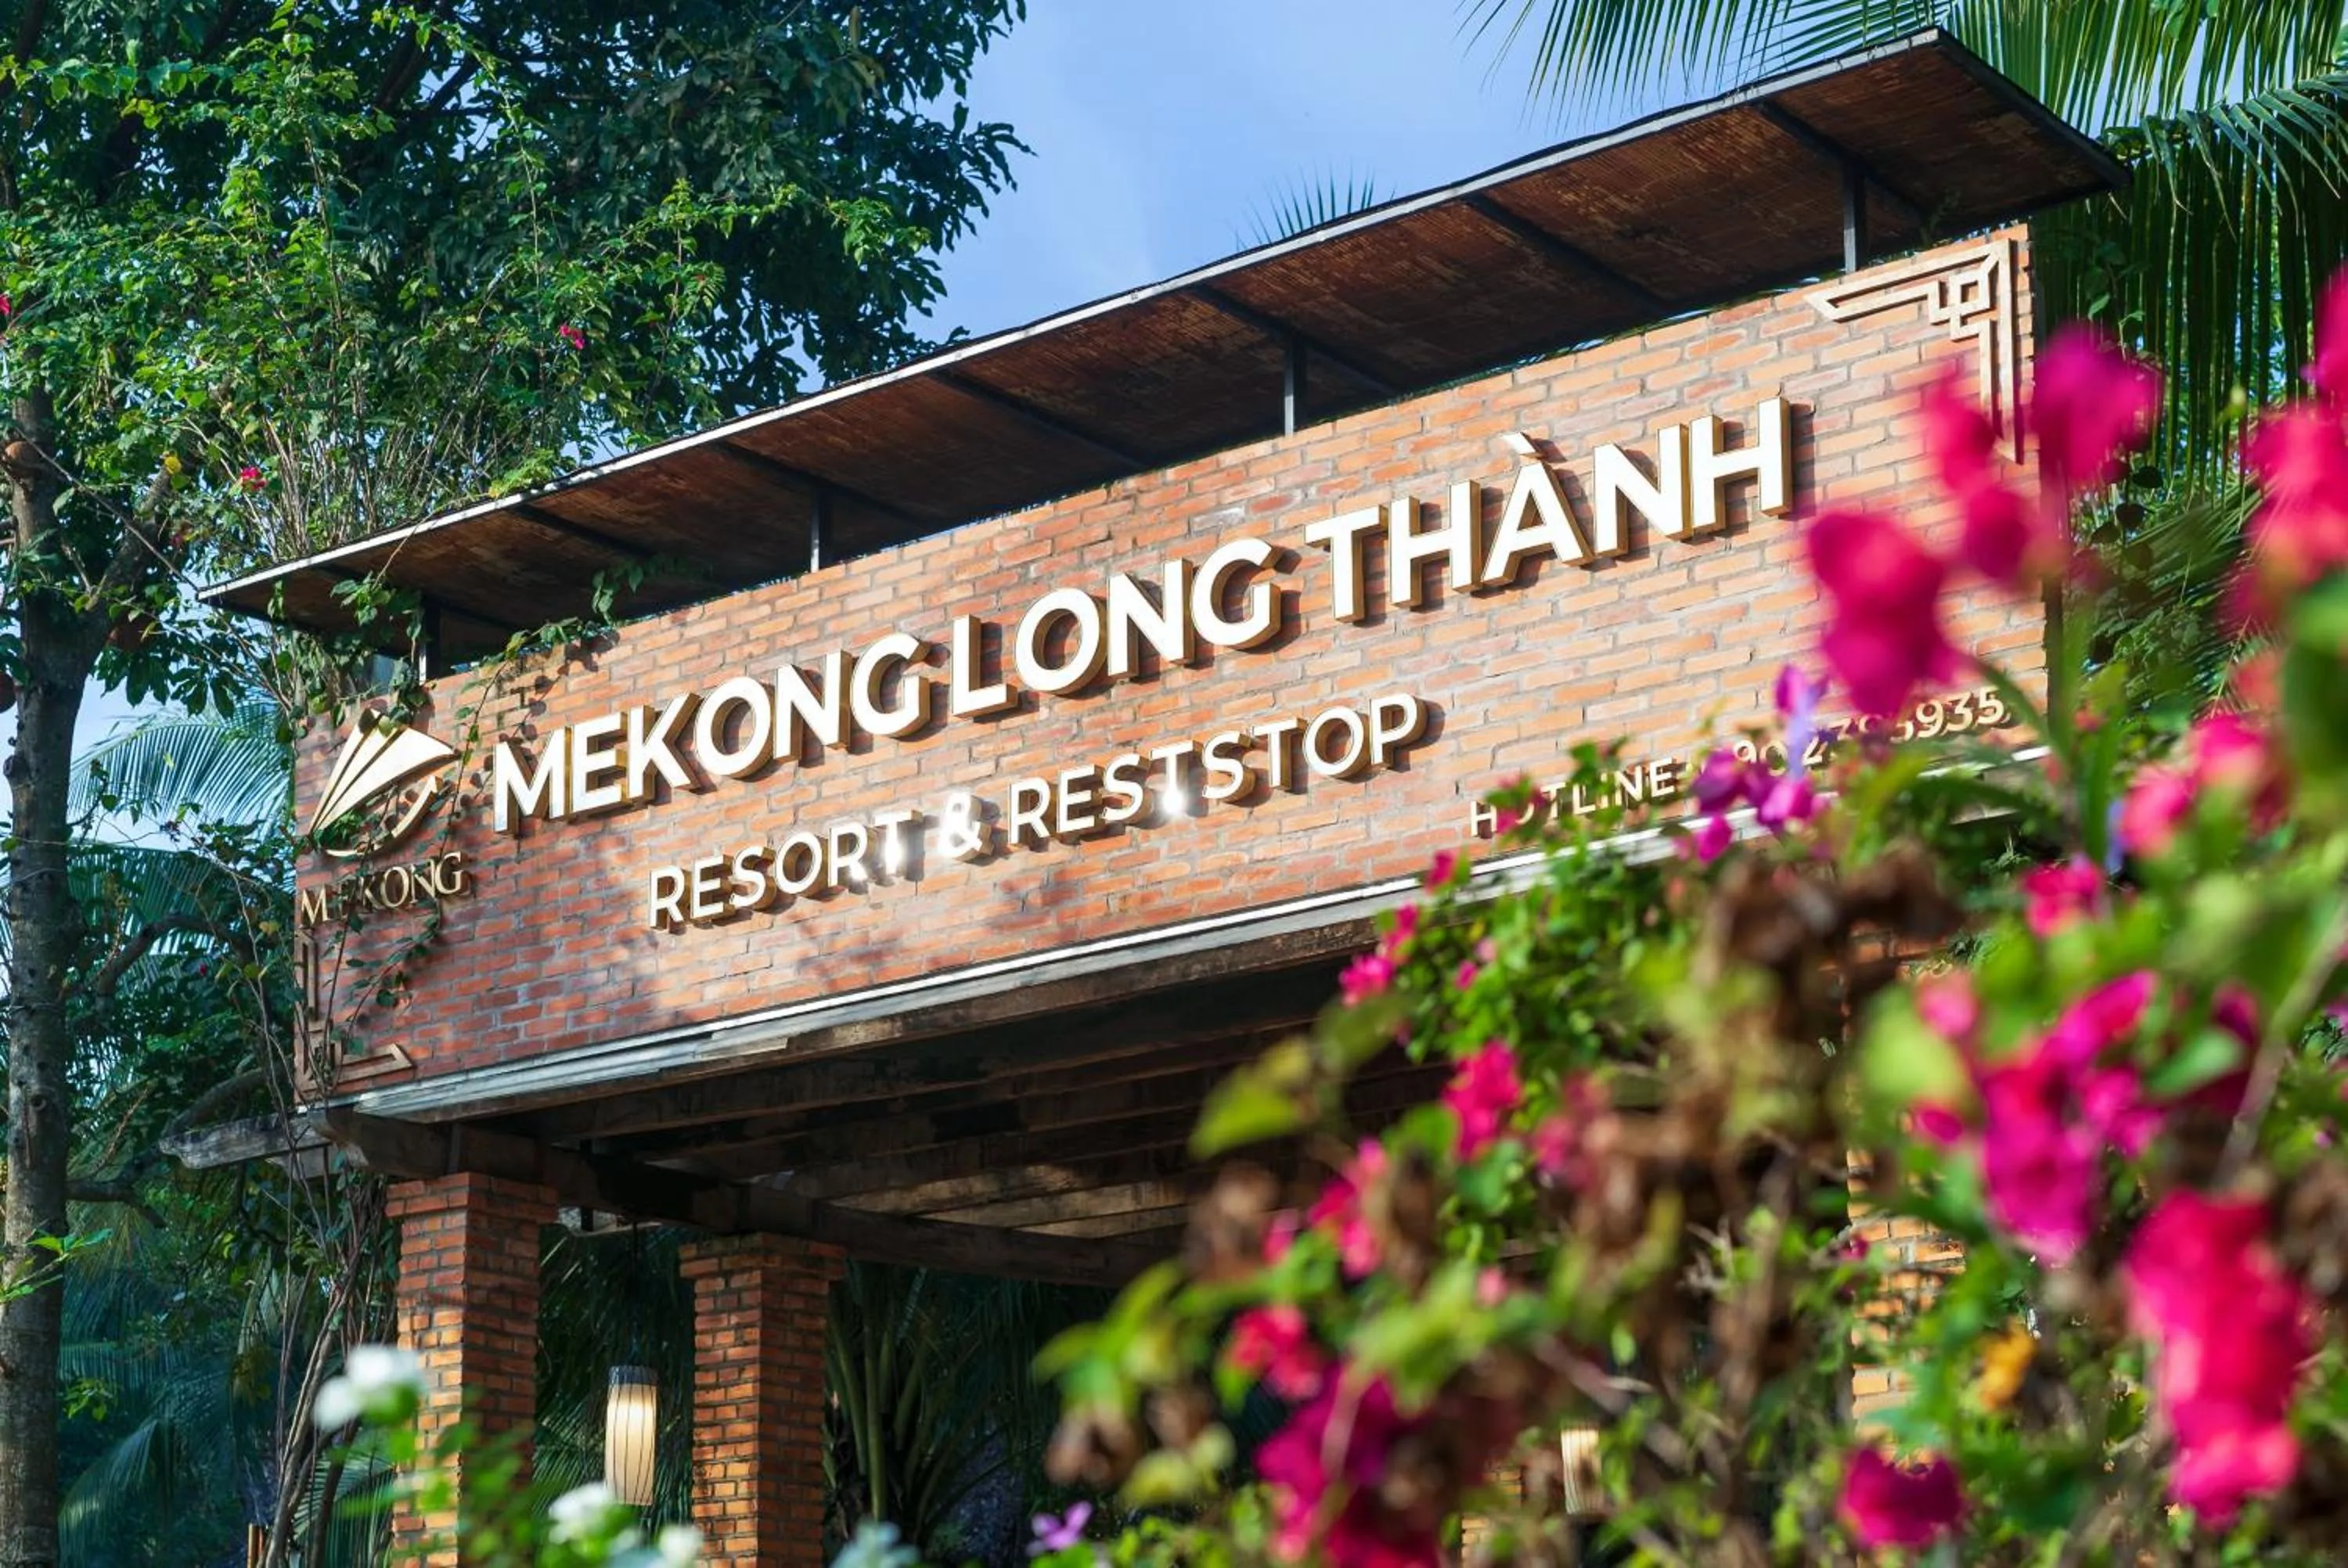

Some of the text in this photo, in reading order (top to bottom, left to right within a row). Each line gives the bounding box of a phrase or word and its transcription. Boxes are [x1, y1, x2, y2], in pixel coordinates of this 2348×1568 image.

[492, 396, 1792, 834] MEKONG LONG THÀNH
[649, 692, 1428, 932] RESORT & RESTSTOP
[1470, 756, 1676, 837] HTLINE
